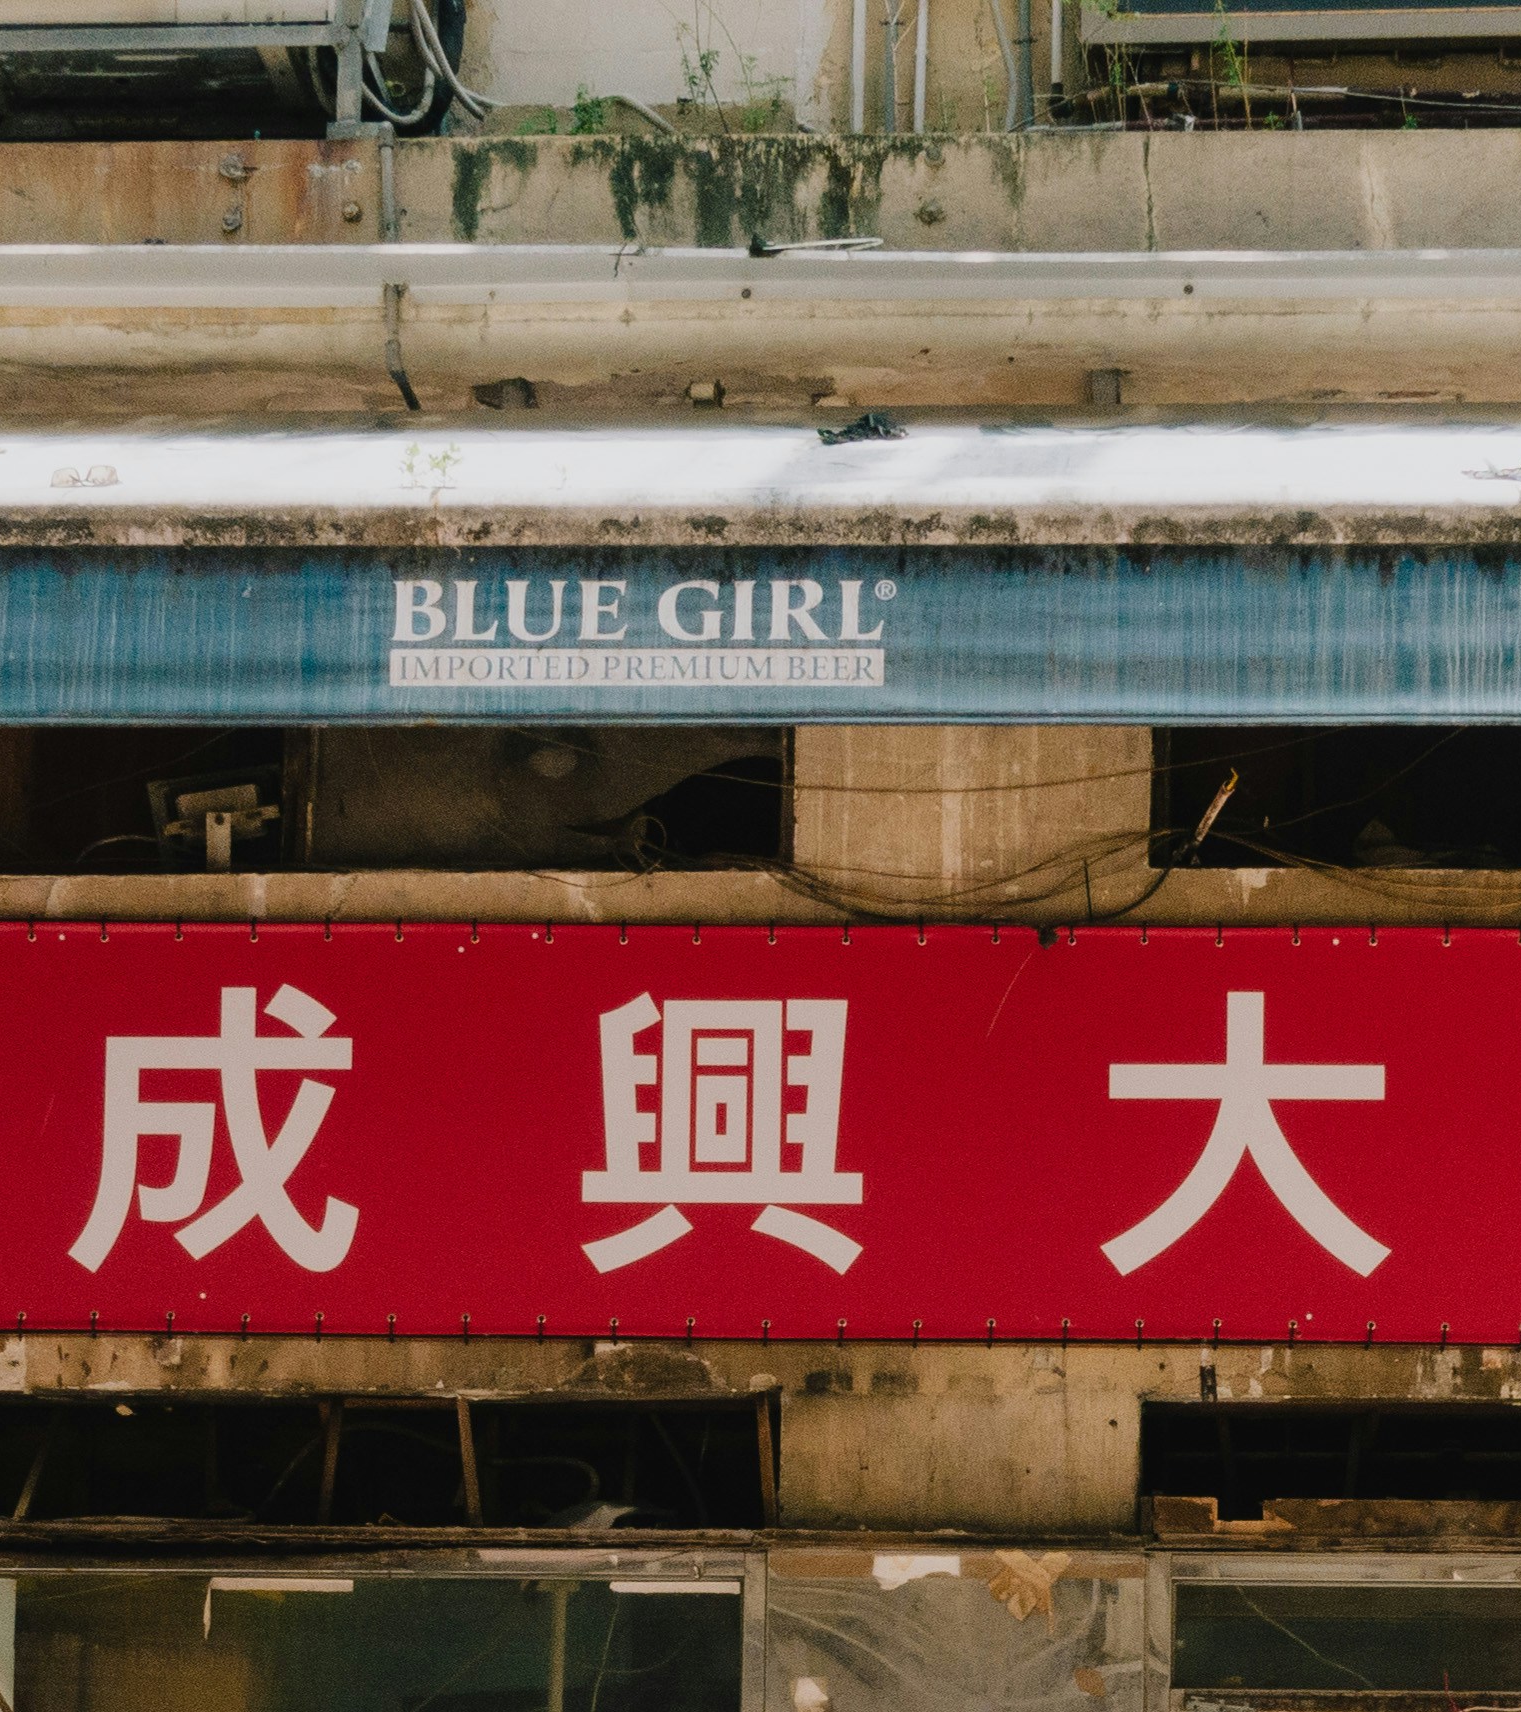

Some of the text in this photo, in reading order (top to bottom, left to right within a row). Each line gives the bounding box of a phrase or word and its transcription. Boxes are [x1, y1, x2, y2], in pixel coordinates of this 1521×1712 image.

[391, 579, 884, 642] BLUE GIRL
[398, 654, 876, 681] IMPORTED PREMIUM BEER
